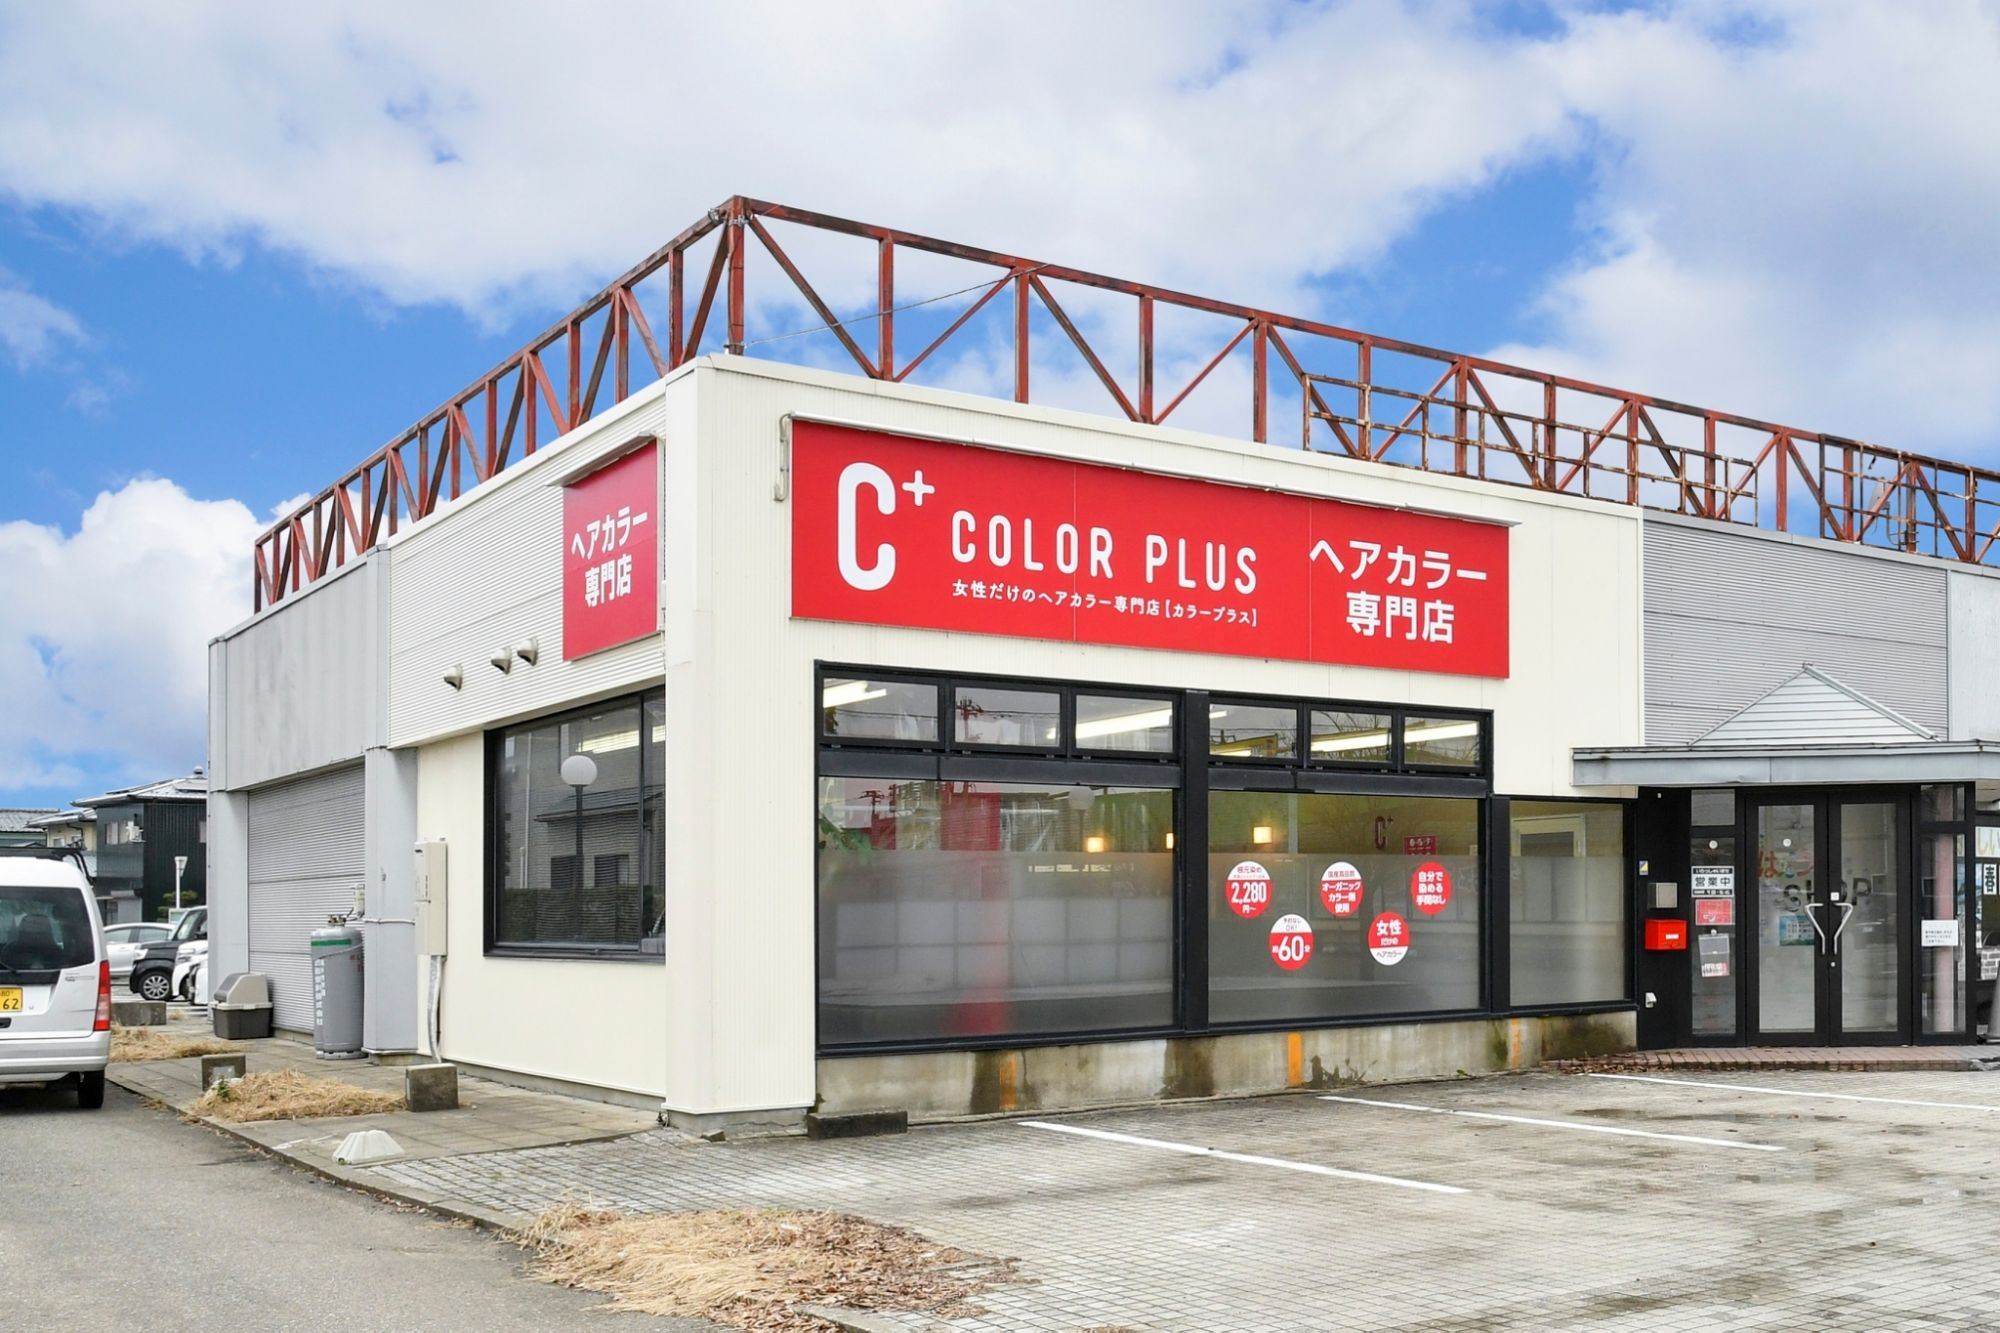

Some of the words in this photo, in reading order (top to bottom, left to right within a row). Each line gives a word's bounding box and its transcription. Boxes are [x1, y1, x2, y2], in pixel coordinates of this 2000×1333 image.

[571, 506, 648, 560] ヘアカラー
[952, 511, 1113, 578] COLOR
[1146, 535, 1256, 594] PLUS
[585, 554, 632, 607] 専門店
[1309, 540, 1486, 589] ヘアカラー
[1346, 591, 1454, 643] 専門店
[1231, 881, 1267, 904] 2,280
[1695, 877, 1731, 887] 営業中
[1376, 919, 1402, 936] 女性
[2, 998, 19, 1010] 62
